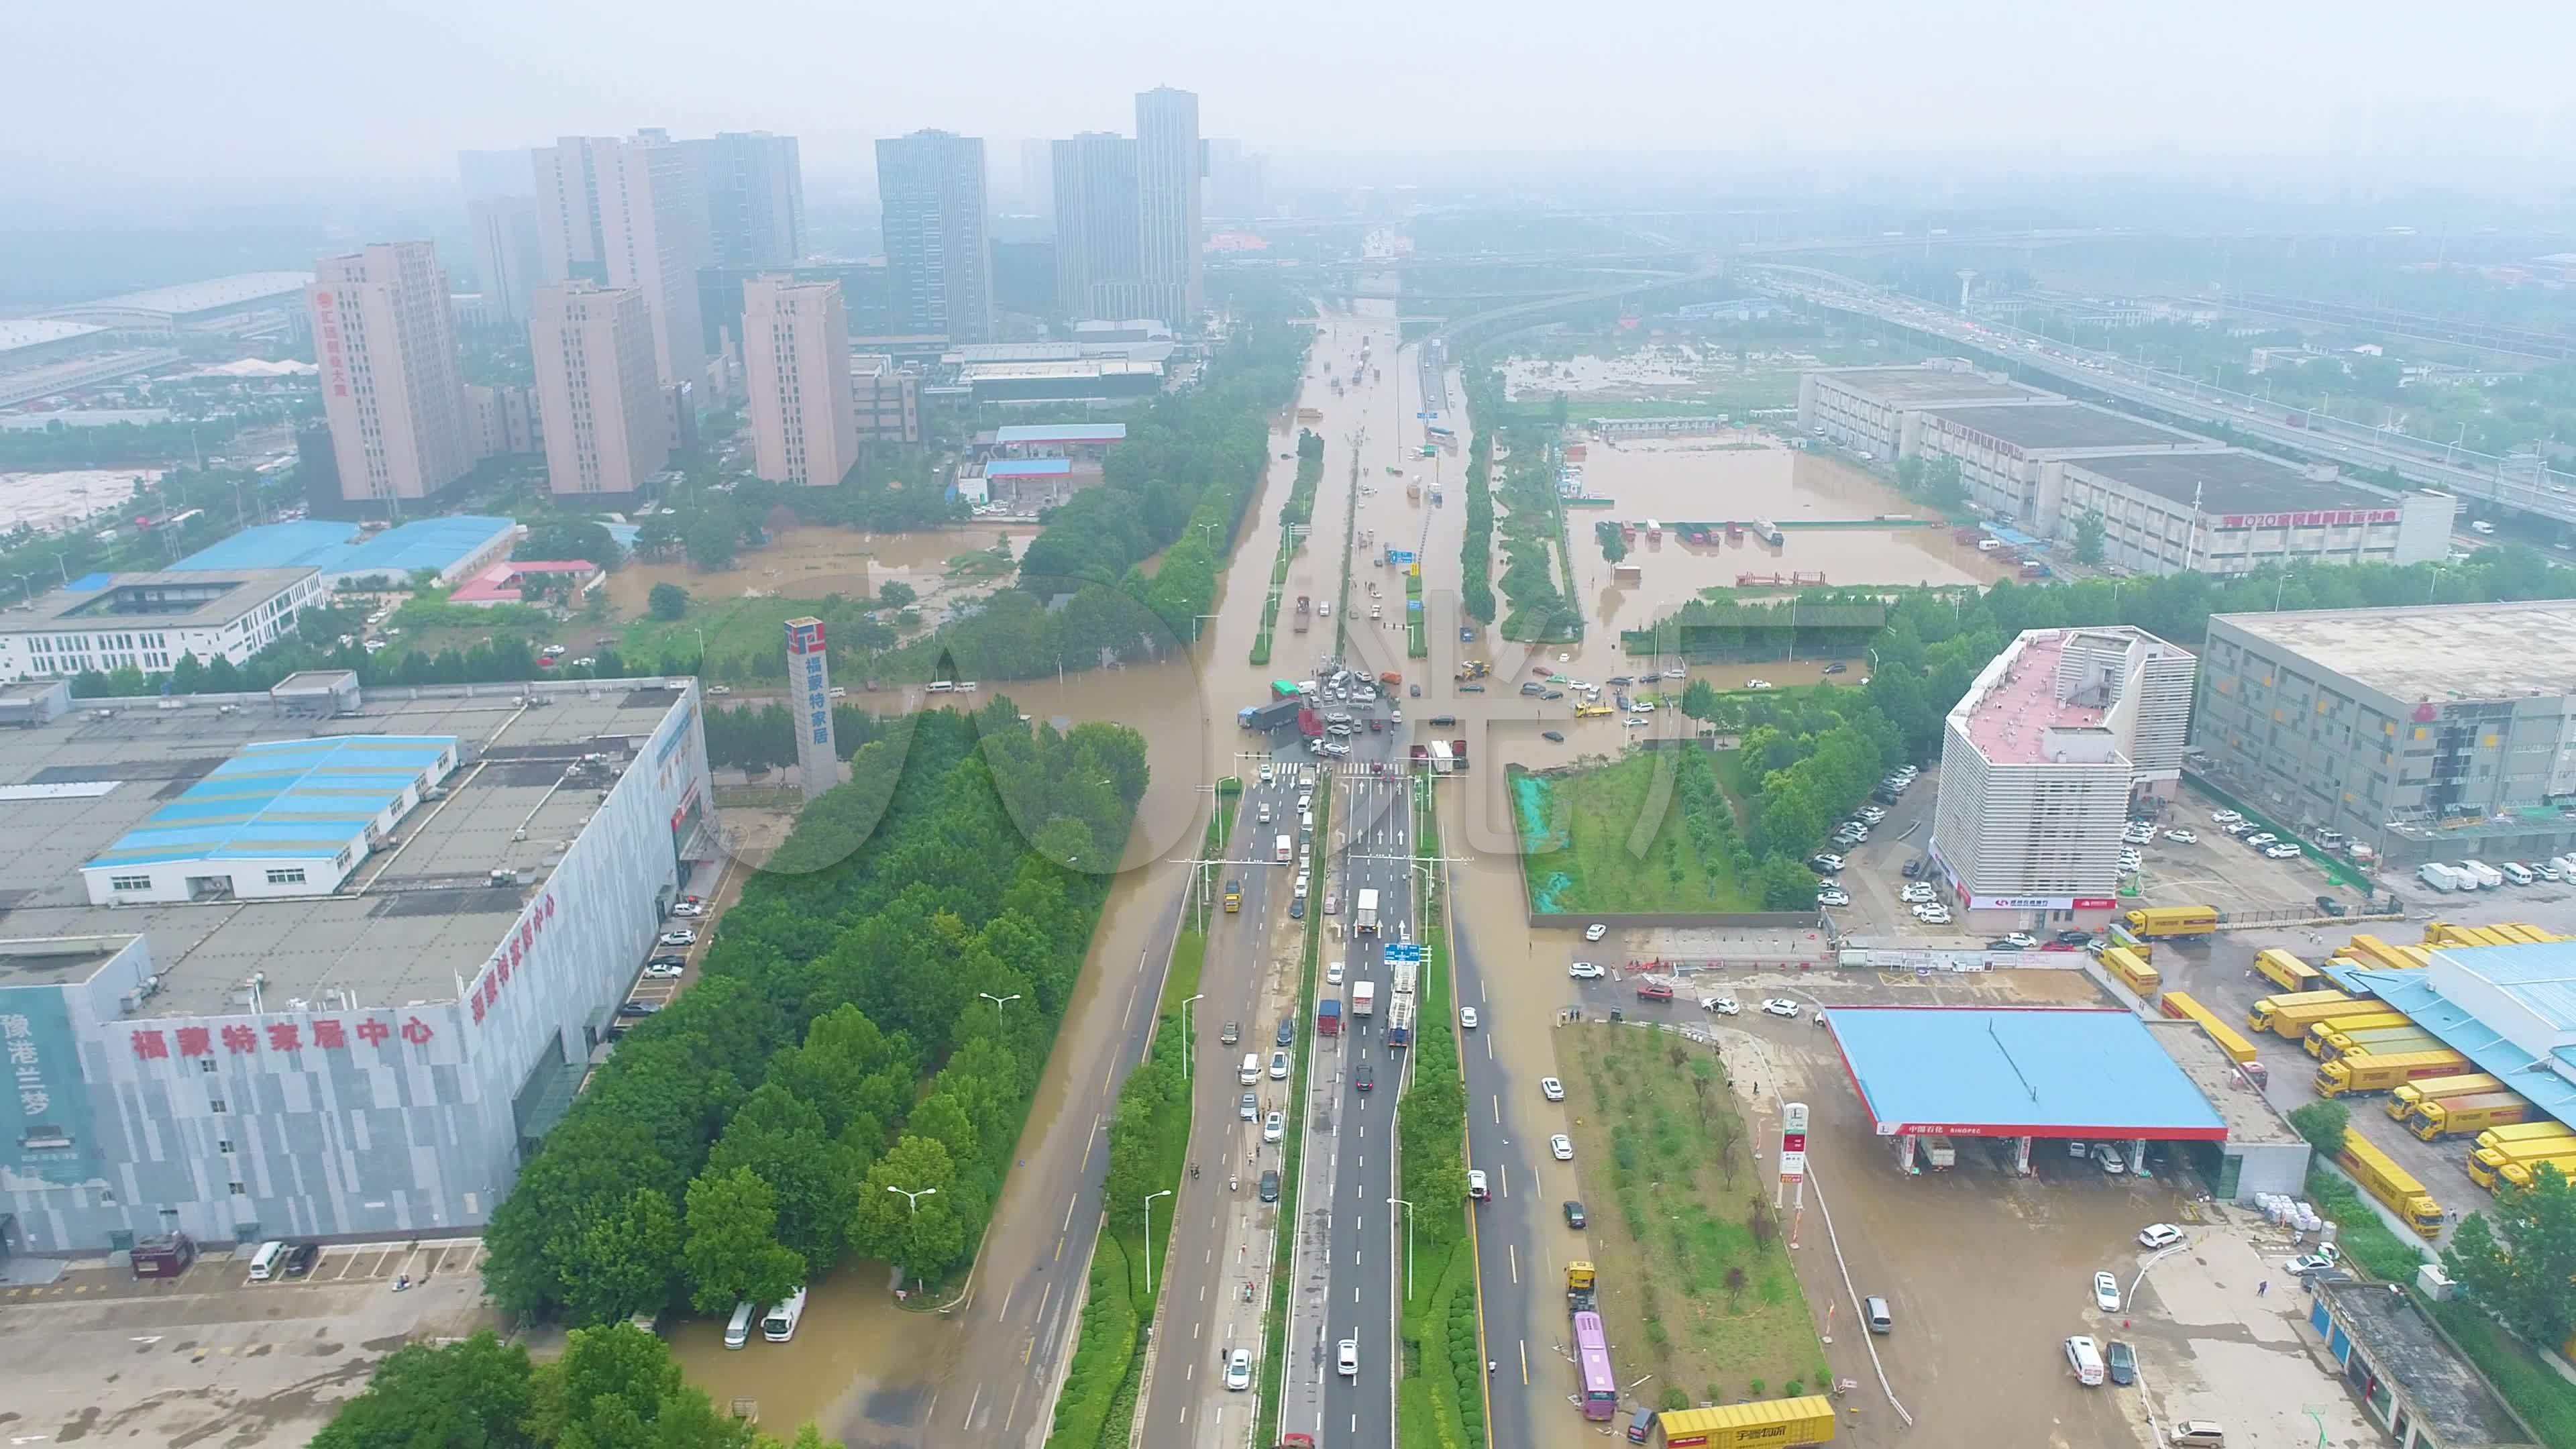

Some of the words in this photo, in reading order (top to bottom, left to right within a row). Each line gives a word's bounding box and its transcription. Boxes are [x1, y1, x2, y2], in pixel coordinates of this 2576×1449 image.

[805, 657, 828, 745] 福蒙特家居
[131, 1015, 435, 1061] 福蒙特家居中心
[1909, 1125, 1943, 1134] 中国石化
